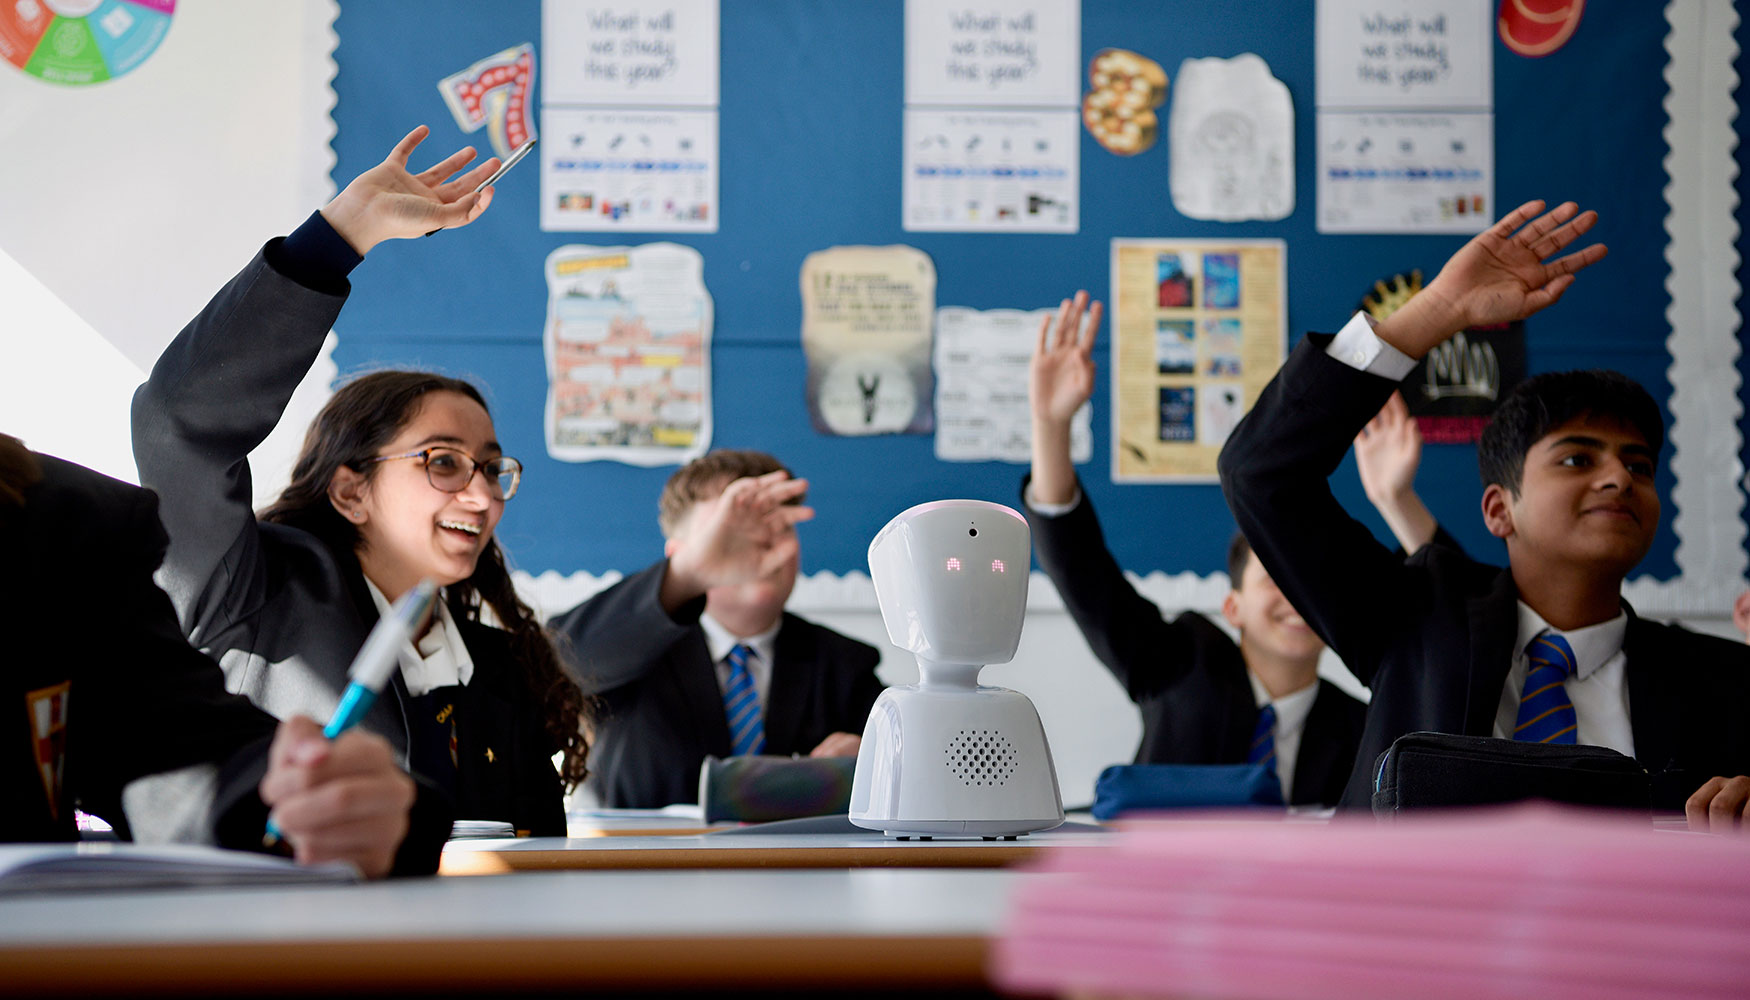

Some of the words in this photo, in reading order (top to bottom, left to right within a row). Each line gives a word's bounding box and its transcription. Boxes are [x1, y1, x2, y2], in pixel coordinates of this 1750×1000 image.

[648, 10, 674, 31] will
[1009, 11, 1035, 32] will
[1418, 13, 1446, 34] will
[587, 39, 614, 55] we
[621, 36, 675, 60] study
[950, 40, 975, 55] we
[983, 37, 1037, 61] study
[1363, 44, 1387, 59] we
[1394, 41, 1447, 66] study
[584, 60, 617, 80] this
[946, 60, 979, 80] this
[1357, 64, 1389, 84] this
